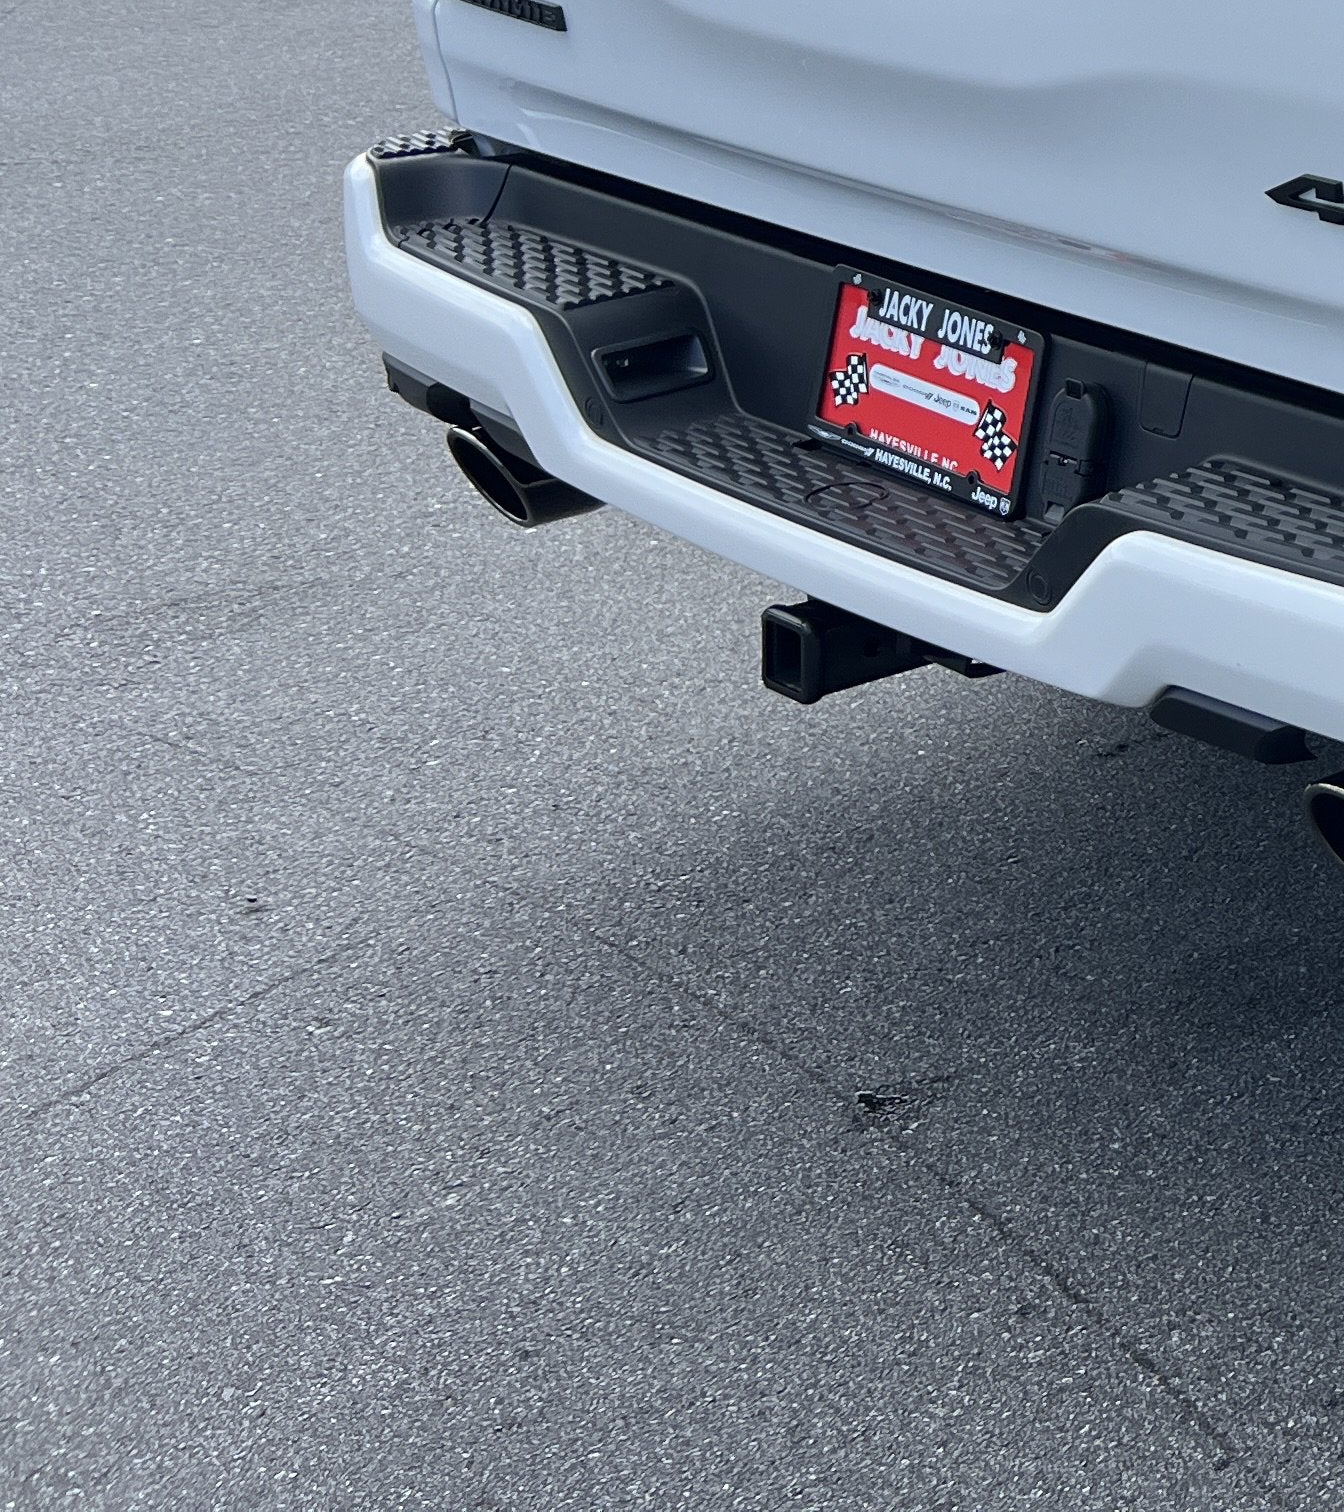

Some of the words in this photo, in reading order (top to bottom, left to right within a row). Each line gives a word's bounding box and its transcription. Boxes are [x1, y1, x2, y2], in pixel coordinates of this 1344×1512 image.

[879, 288, 934, 332] JACKY
[938, 308, 994, 355] JONES
[875, 448, 932, 485] HAYESVILLE,
[971, 487, 998, 509] Jeep
